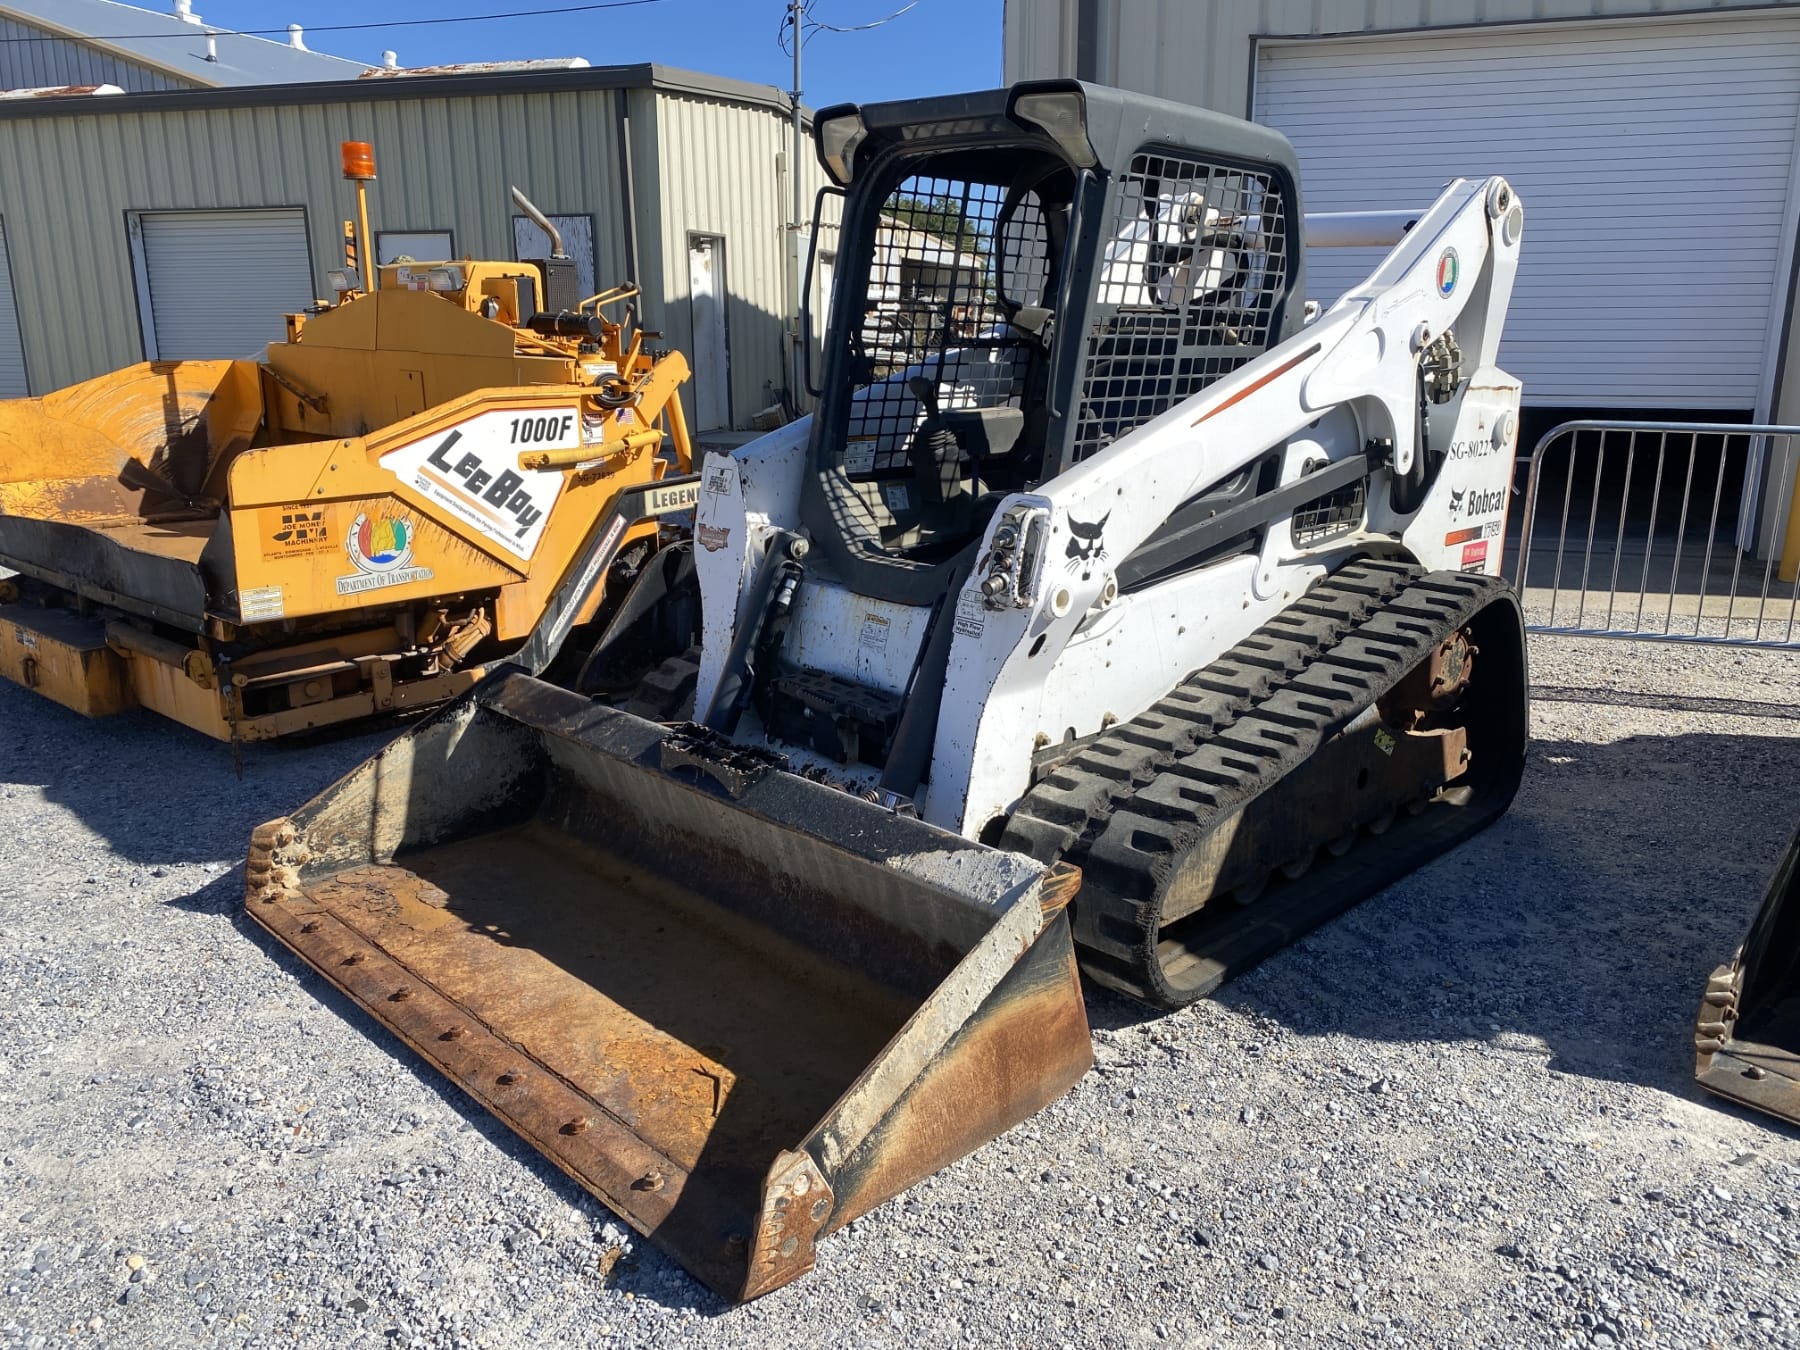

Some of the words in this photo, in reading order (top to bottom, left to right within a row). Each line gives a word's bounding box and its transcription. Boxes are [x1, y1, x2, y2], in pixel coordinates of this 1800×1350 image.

[510, 415, 573, 444] 1000F
[426, 429, 543, 539] LeeBoy
[652, 487, 700, 509] LEGEN
[1467, 486, 1506, 517] Bobcat
[337, 577, 376, 593] DEPARTMENT
